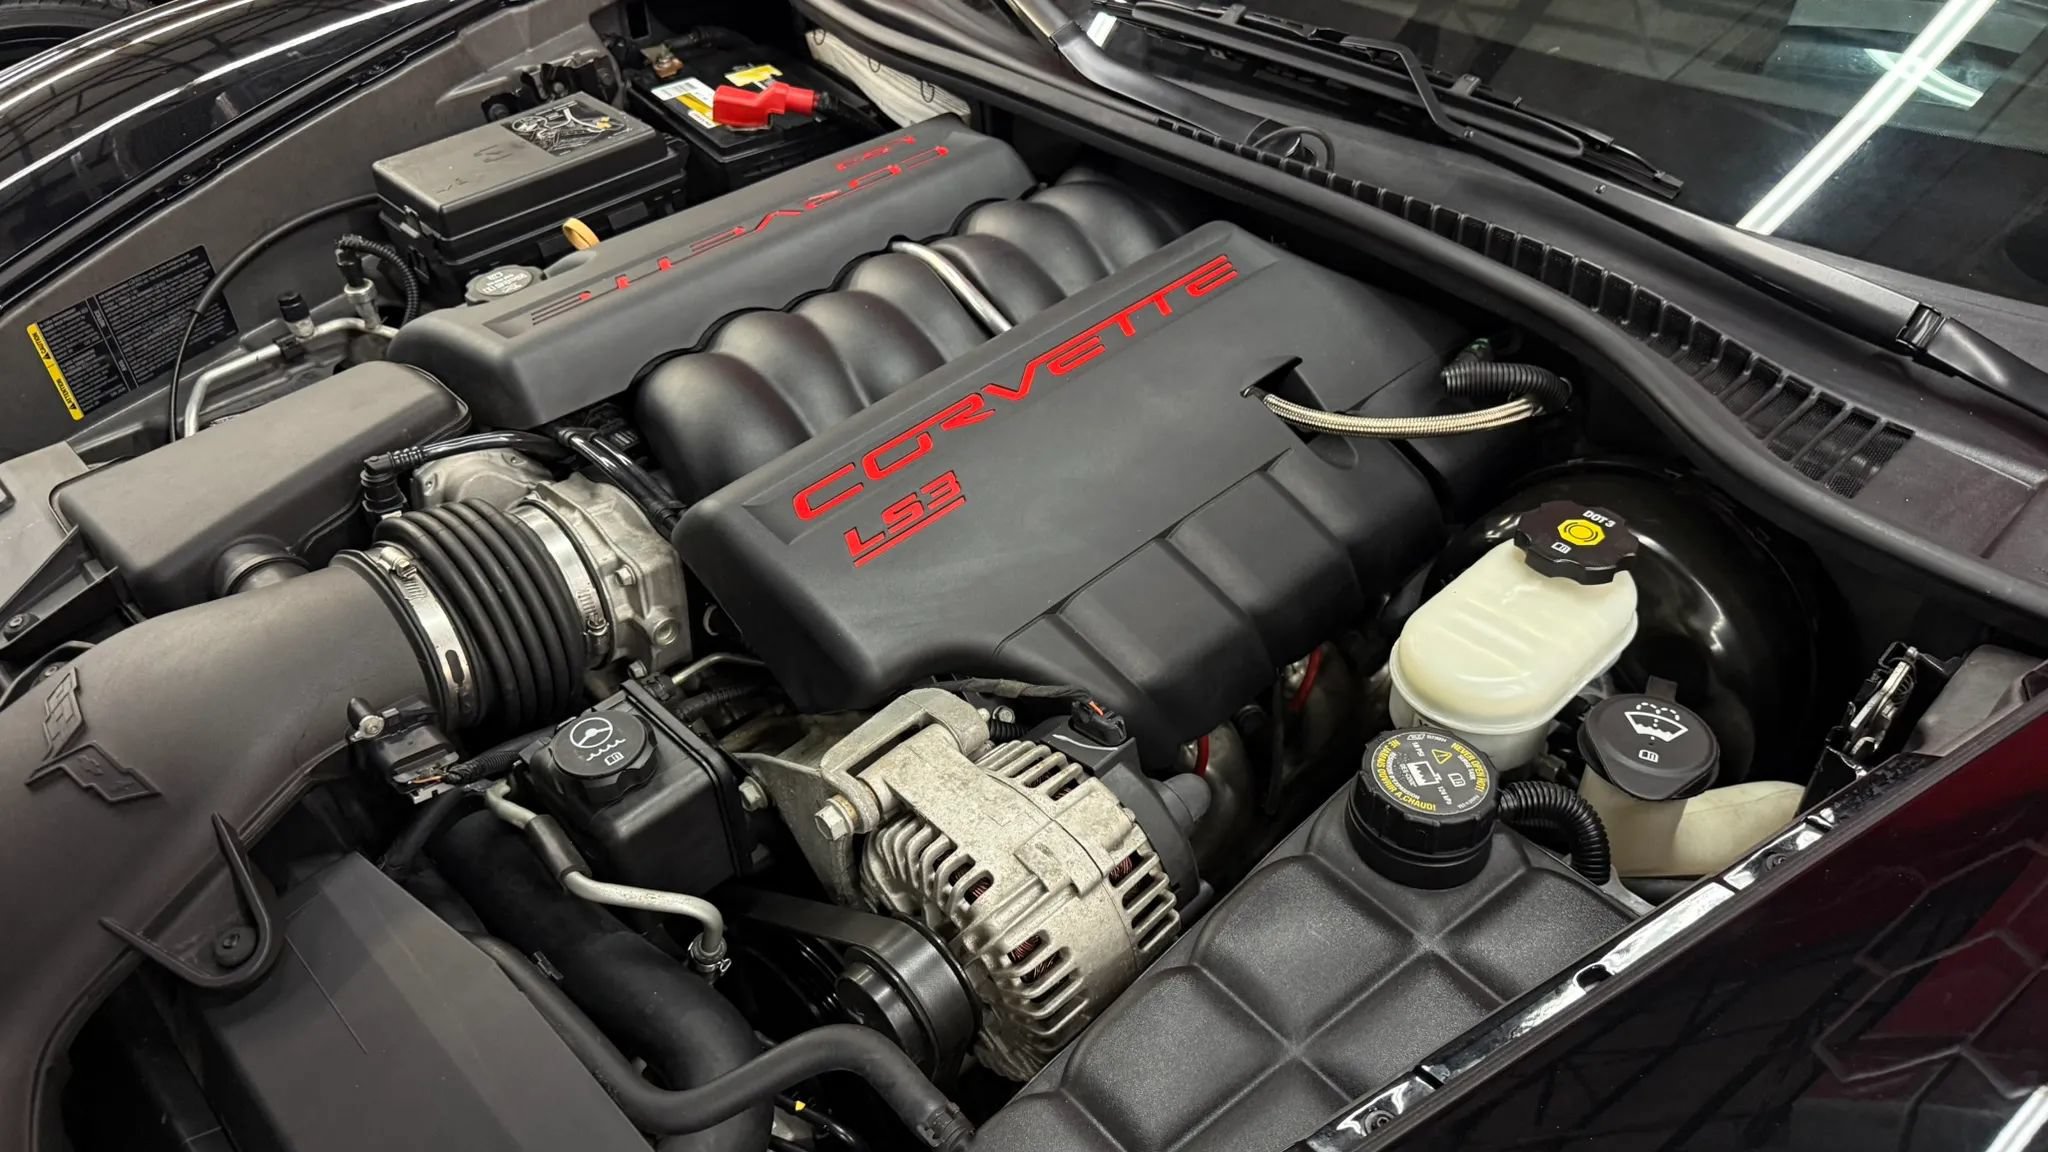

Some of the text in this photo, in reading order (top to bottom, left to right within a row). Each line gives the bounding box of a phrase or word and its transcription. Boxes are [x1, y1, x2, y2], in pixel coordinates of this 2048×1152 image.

[32, 332, 47, 354] CAUTION
[56, 378, 73, 404] ATTENTION
[792, 253, 1241, 522] CORVETTE
[843, 469, 965, 563] LS3
[1582, 509, 1616, 528] DOT 3
[1388, 739, 1401, 749] NE
[1415, 748, 1425, 757] PSI
[1376, 745, 1392, 768] JAMAIS
[1451, 743, 1476, 761] NEVER
[1470, 760, 1486, 777] OPEN
[1377, 768, 1398, 792] OUVRIR
[1402, 795, 1437, 811] CHAUD!
